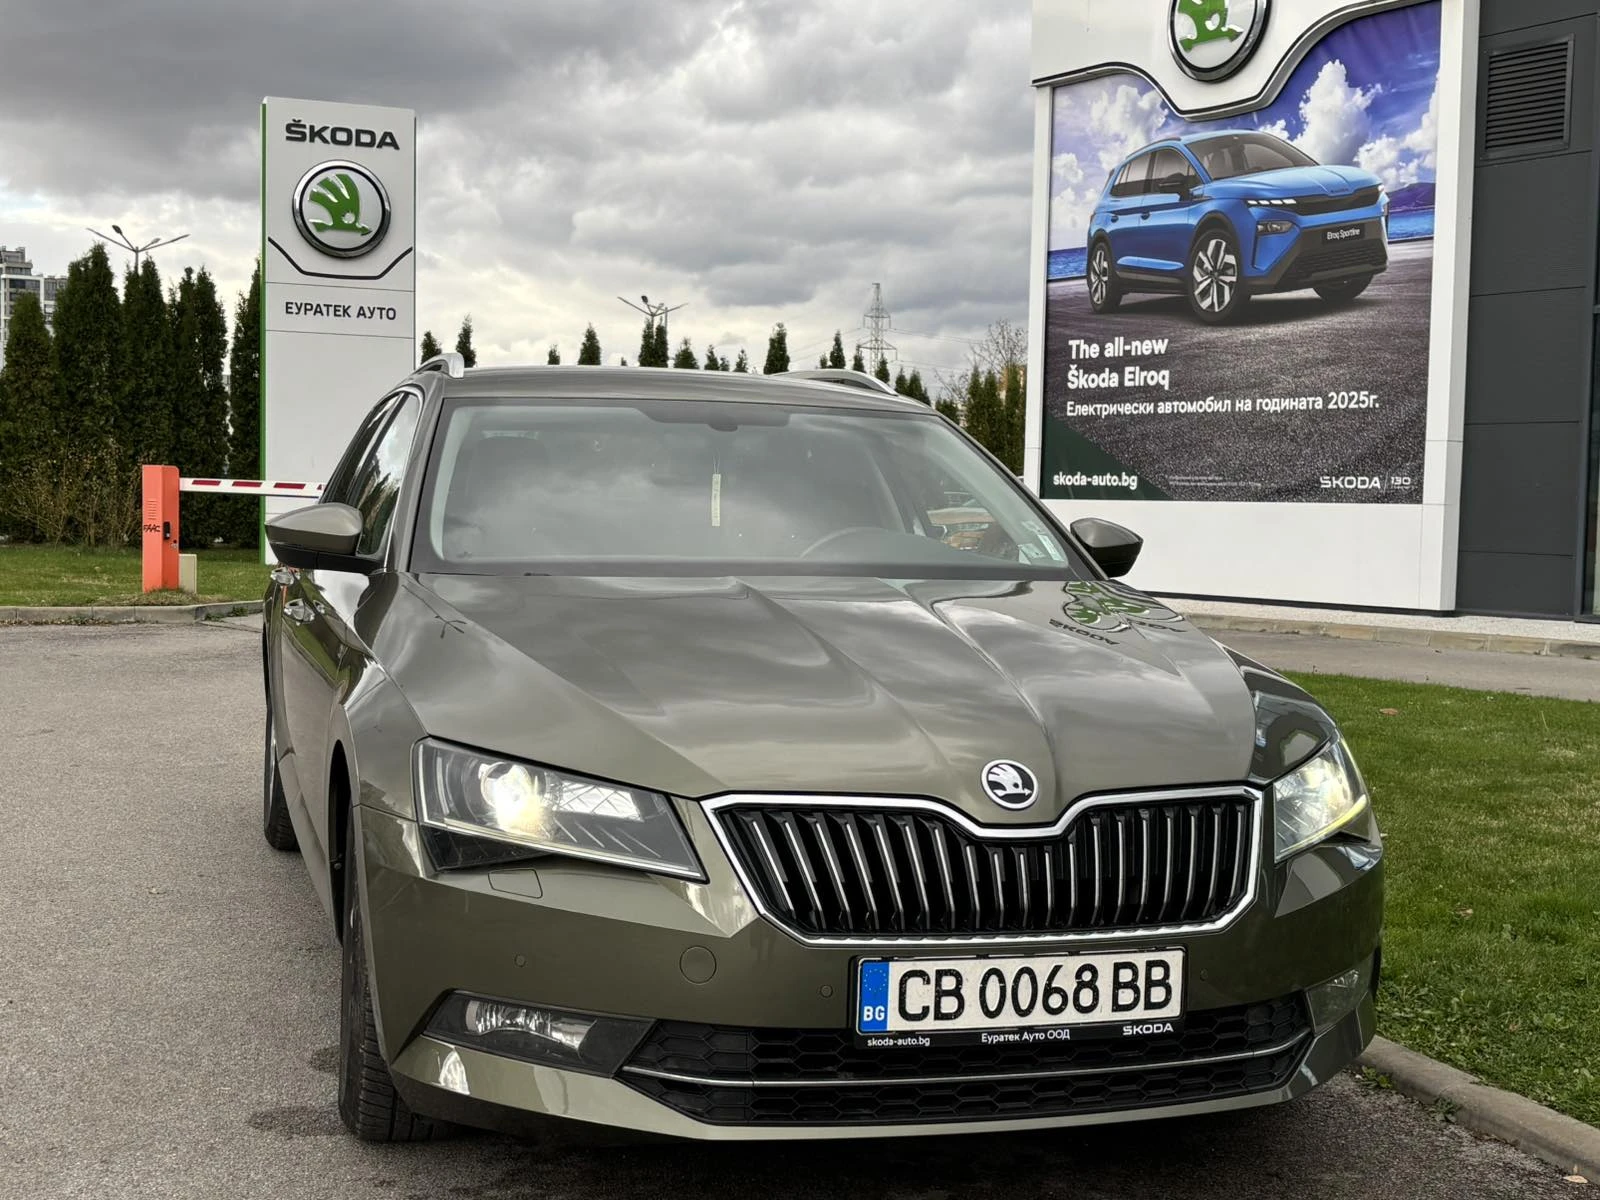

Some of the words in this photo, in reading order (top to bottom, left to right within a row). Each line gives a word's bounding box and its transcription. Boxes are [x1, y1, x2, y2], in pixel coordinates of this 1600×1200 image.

[285, 118, 400, 150] ŠKODA
[285, 301, 352, 318] ЕУРАТЕК
[356, 305, 397, 321] АУТО
[1068, 339, 1100, 359] The
[1104, 336, 1169, 358] all-new
[1067, 364, 1119, 389] Škoda
[1124, 366, 1170, 390] Elroq
[1066, 401, 1154, 419] Електрически
[1157, 397, 1231, 414] автомобил
[1235, 399, 1252, 411] на
[1256, 397, 1323, 413] годината
[1327, 391, 1380, 410] 2025г.
[1053, 471, 1138, 491] skoda-auto.bg
[898, 968, 965, 1022] CB
[979, 963, 1100, 1019] 0068
[1111, 959, 1173, 1013] BB
[863, 1005, 886, 1022] BG
[867, 1036, 931, 1047] skoda-auto.bg
[981, 1032, 1020, 1044] Еуратек
[1022, 1031, 1046, 1042] Ауто
[1047, 1029, 1071, 1040] ООД
